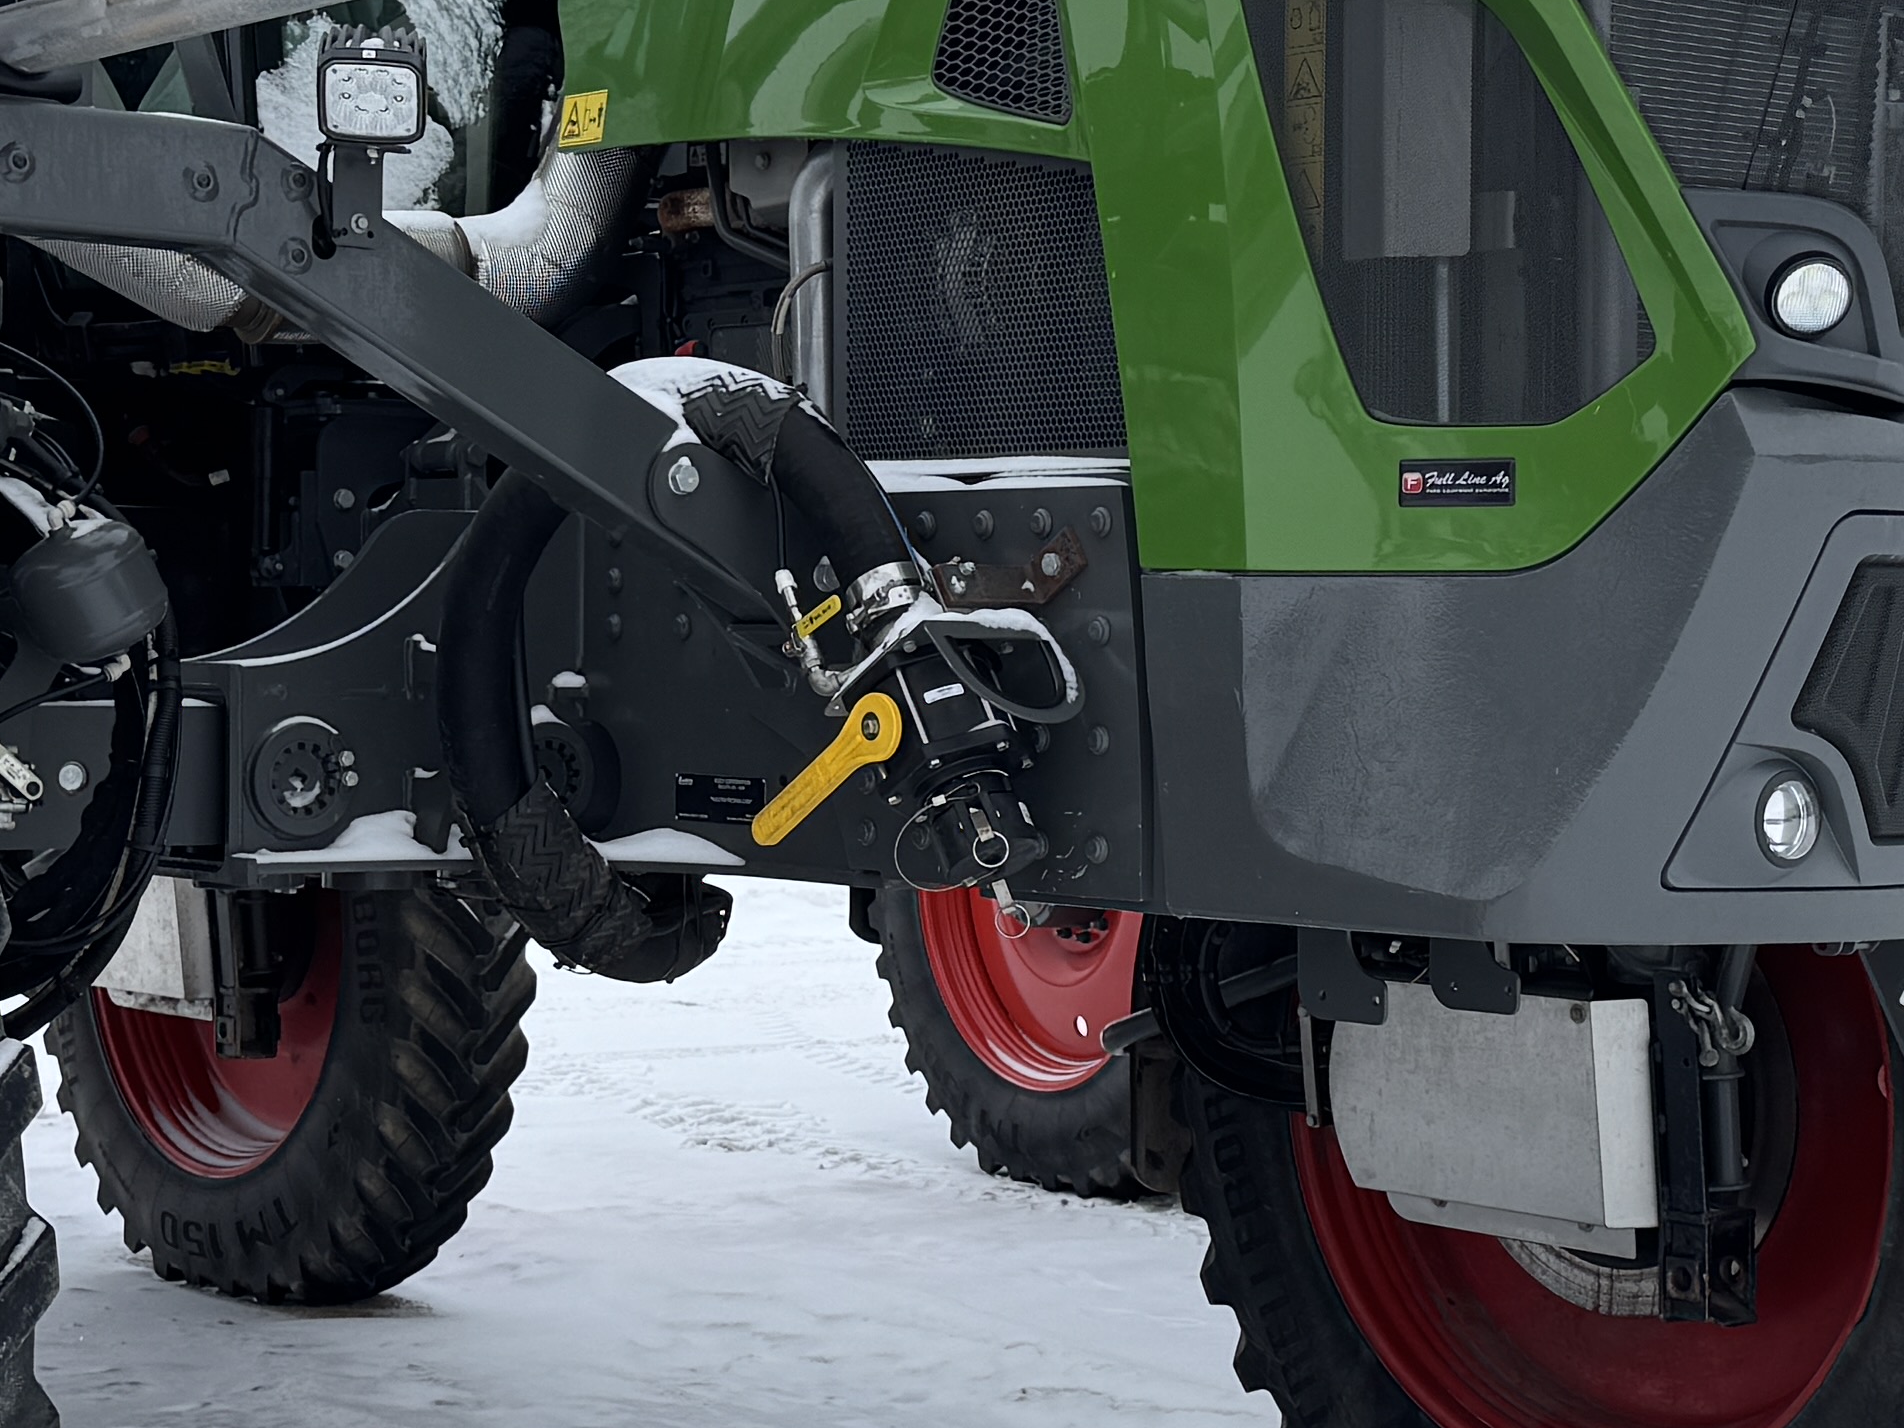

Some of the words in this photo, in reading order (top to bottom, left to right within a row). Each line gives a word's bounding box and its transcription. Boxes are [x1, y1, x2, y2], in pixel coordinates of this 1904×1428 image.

[1425, 471, 1455, 487] Full
[1456, 471, 1486, 484] Line
[1489, 470, 1510, 488] Ag
